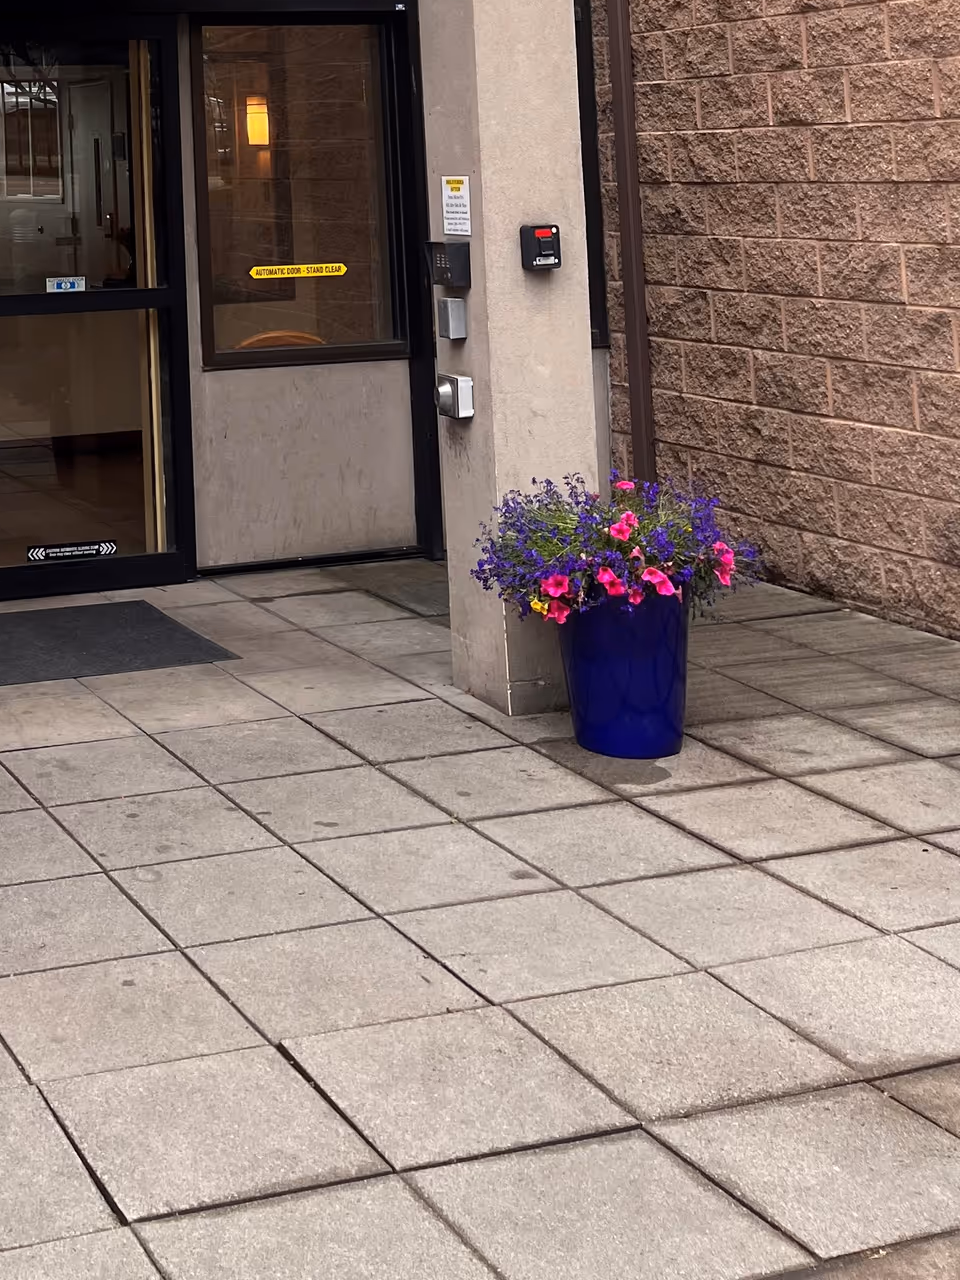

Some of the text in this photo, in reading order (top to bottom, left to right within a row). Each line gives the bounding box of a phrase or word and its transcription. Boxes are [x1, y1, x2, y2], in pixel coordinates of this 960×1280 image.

[255, 267, 286, 276] AUTOMATIC
[287, 267, 301, 275] DOOR
[306, 266, 324, 274] STAND
[325, 265, 342, 274] CLEAR
